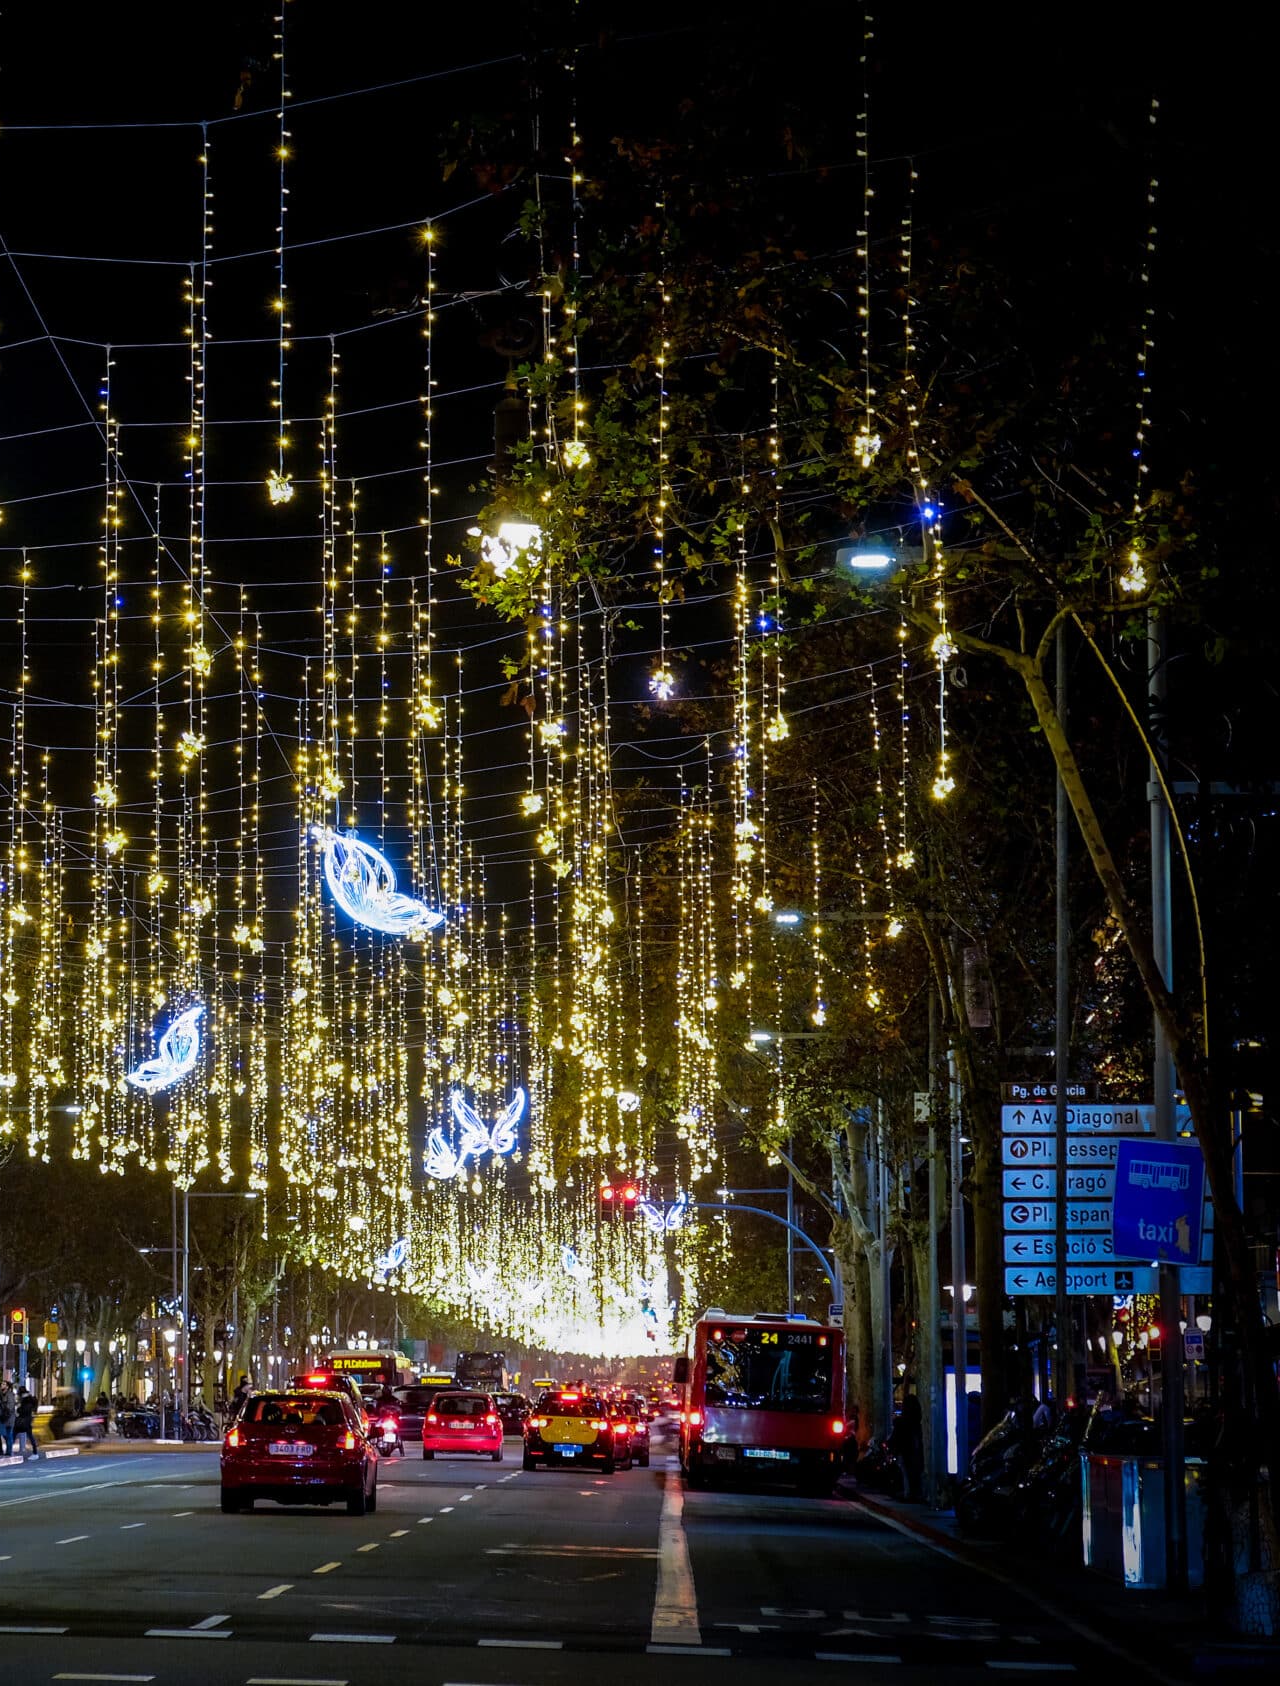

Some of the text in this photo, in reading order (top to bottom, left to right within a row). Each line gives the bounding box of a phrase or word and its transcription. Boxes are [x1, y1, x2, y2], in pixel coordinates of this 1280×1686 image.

[1012, 1084, 1086, 1099] Pg. de Gcia
[1032, 1109, 1139, 1128] Av. Diagonal
[1032, 1141, 1118, 1161] Pl. essep
[1032, 1173, 1107, 1193] C. ragó
[1032, 1206, 1111, 1225] Pl. span
[1138, 1218, 1174, 1244] taxi
[1033, 1238, 1097, 1255] Esció
[1035, 1271, 1108, 1291] Aeoport
[761, 1332, 812, 1345] 24 2441
[333, 1360, 343, 1369] 22
